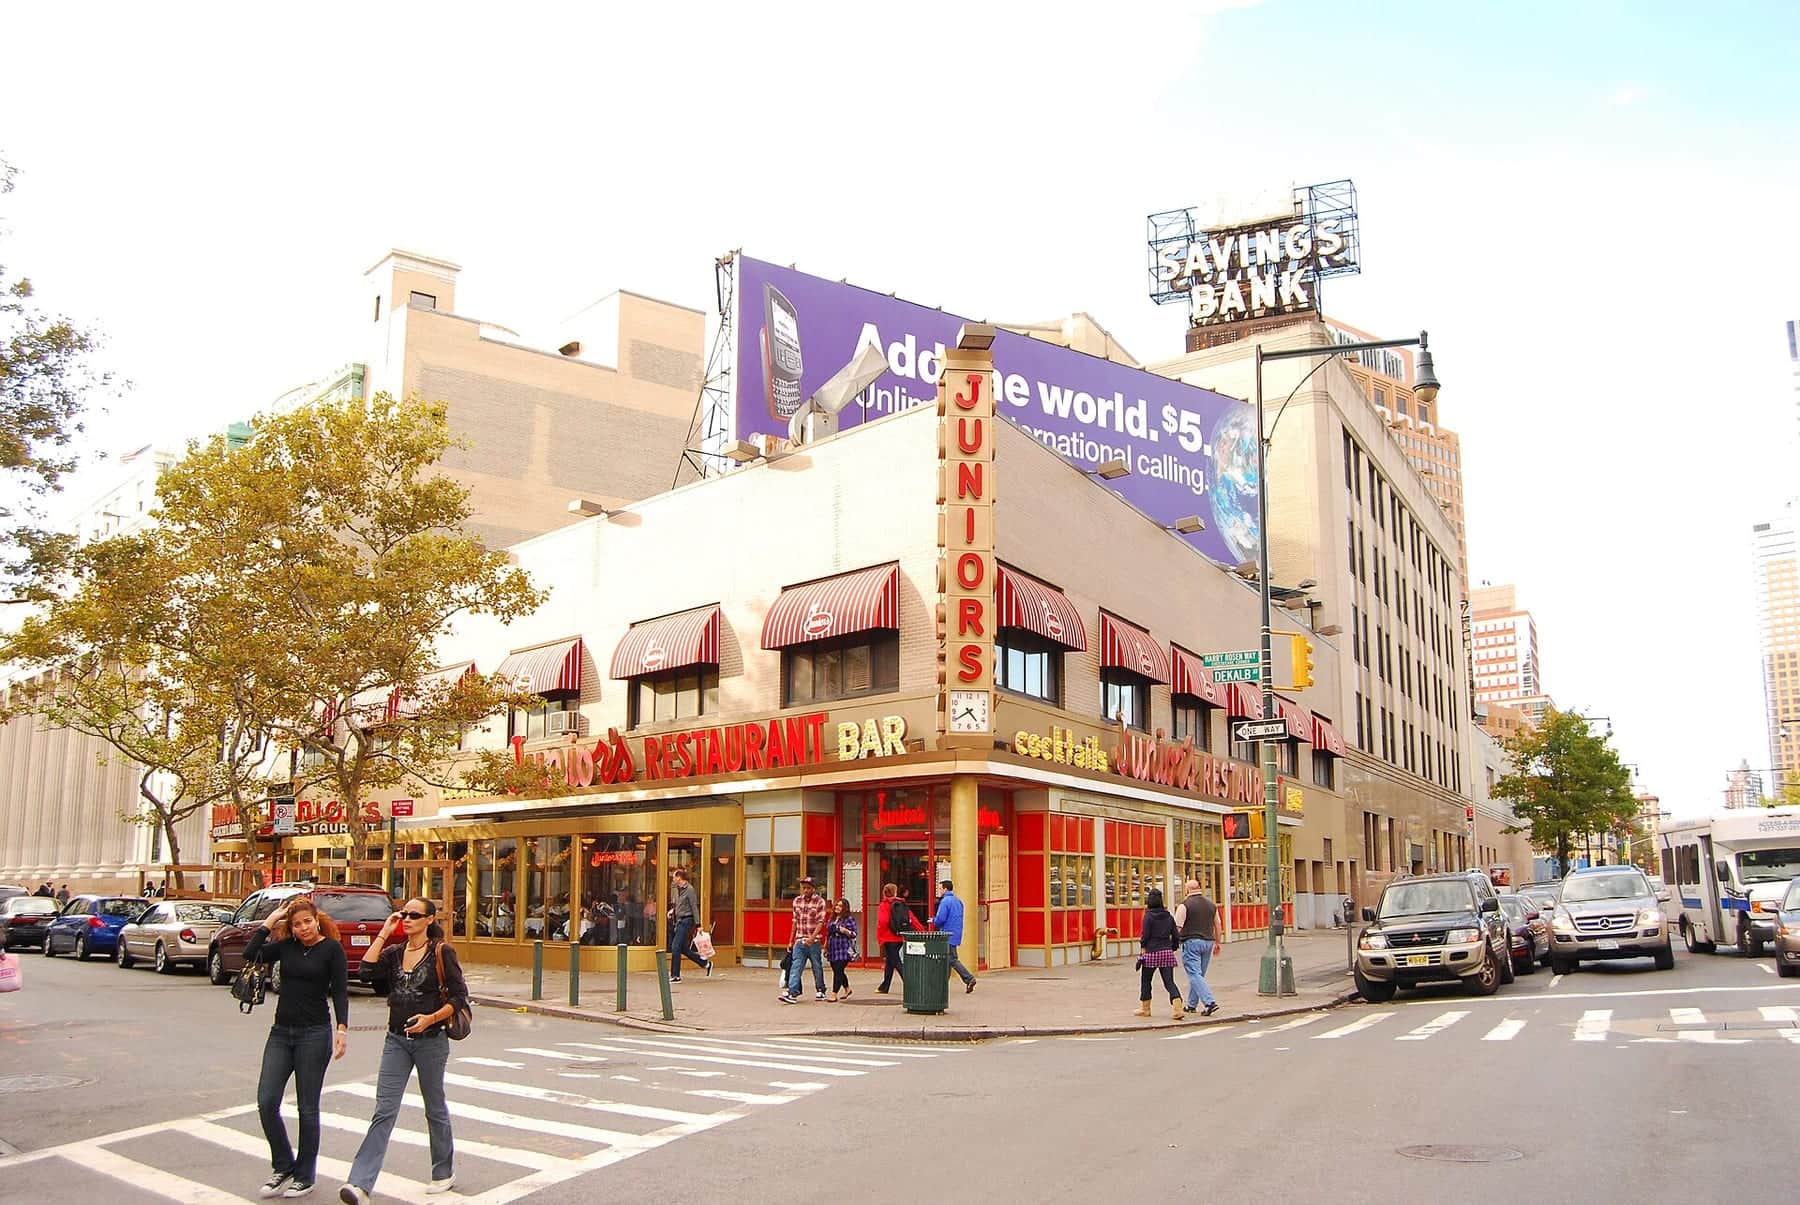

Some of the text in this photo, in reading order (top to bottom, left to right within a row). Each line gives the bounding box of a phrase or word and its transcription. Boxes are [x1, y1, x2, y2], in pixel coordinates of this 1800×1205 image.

[1157, 219, 1342, 282] SAVINGS
[1190, 268, 1310, 320] BANK
[1037, 381, 1160, 443] world.
[1161, 402, 1212, 457] $5.
[1137, 453, 1209, 495] calling.
[955, 373, 986, 683] JUNIORS
[1214, 669, 1251, 682] DEKALB
[644, 711, 829, 780] RESTAURANT
[838, 715, 908, 761] BAR
[1241, 725, 1281, 736] ONE WAY
